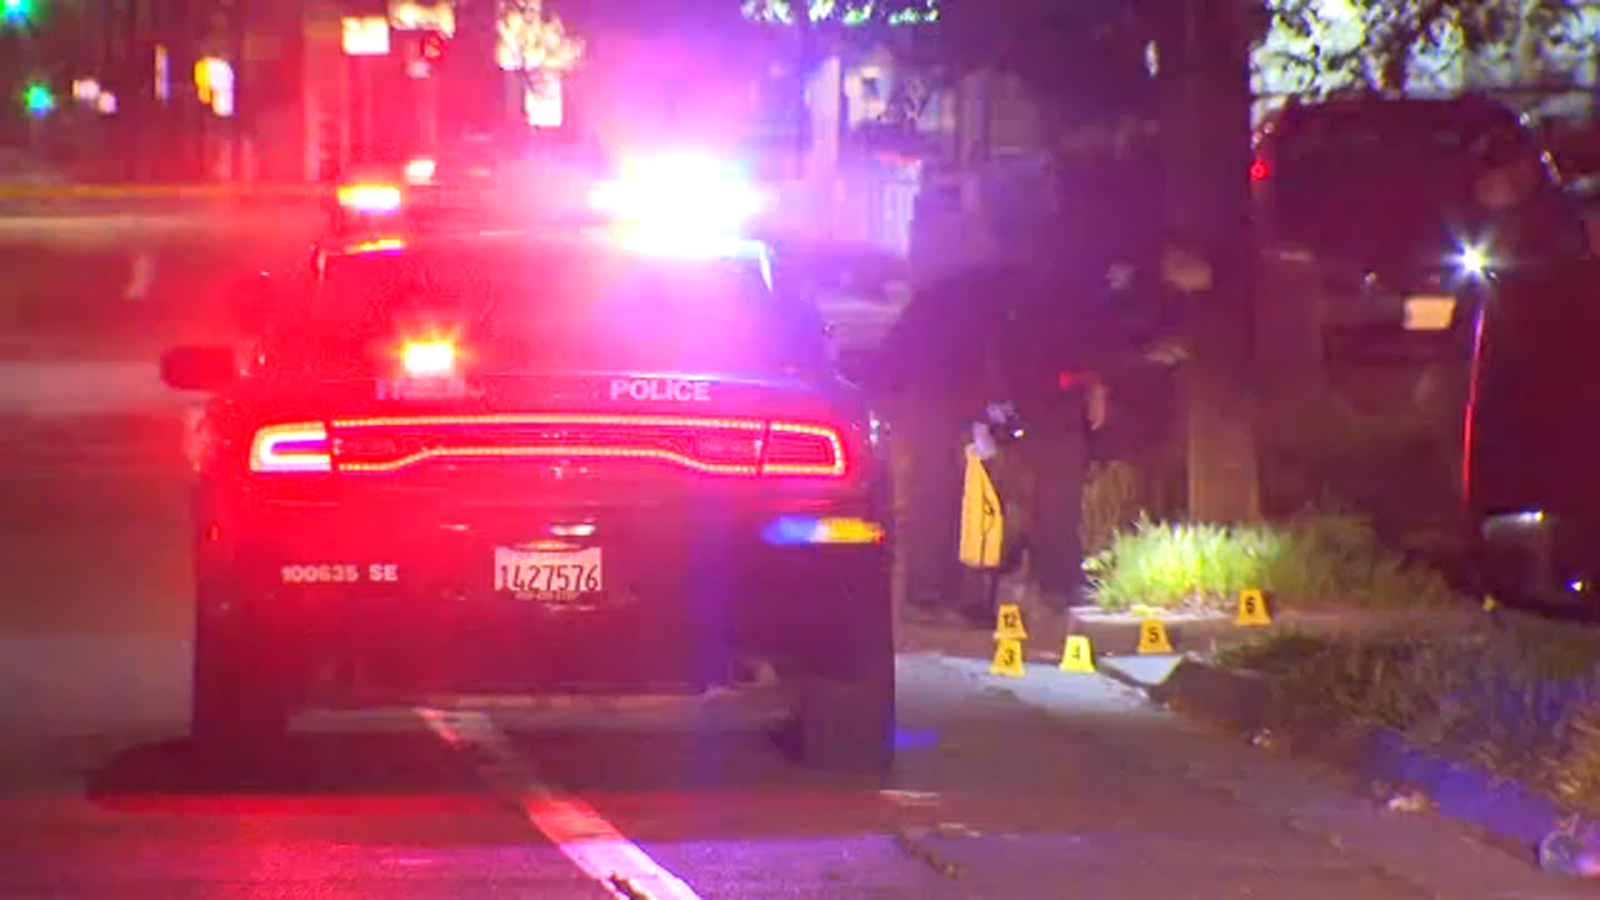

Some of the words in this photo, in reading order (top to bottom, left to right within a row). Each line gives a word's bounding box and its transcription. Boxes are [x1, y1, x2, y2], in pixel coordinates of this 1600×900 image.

[609, 378, 712, 402] POLICE
[368, 563, 399, 582] SE
[499, 563, 599, 591] 1427576
[1244, 595, 1256, 615] 6
[1148, 626, 1160, 644] 5
[1003, 647, 1015, 667] 3
